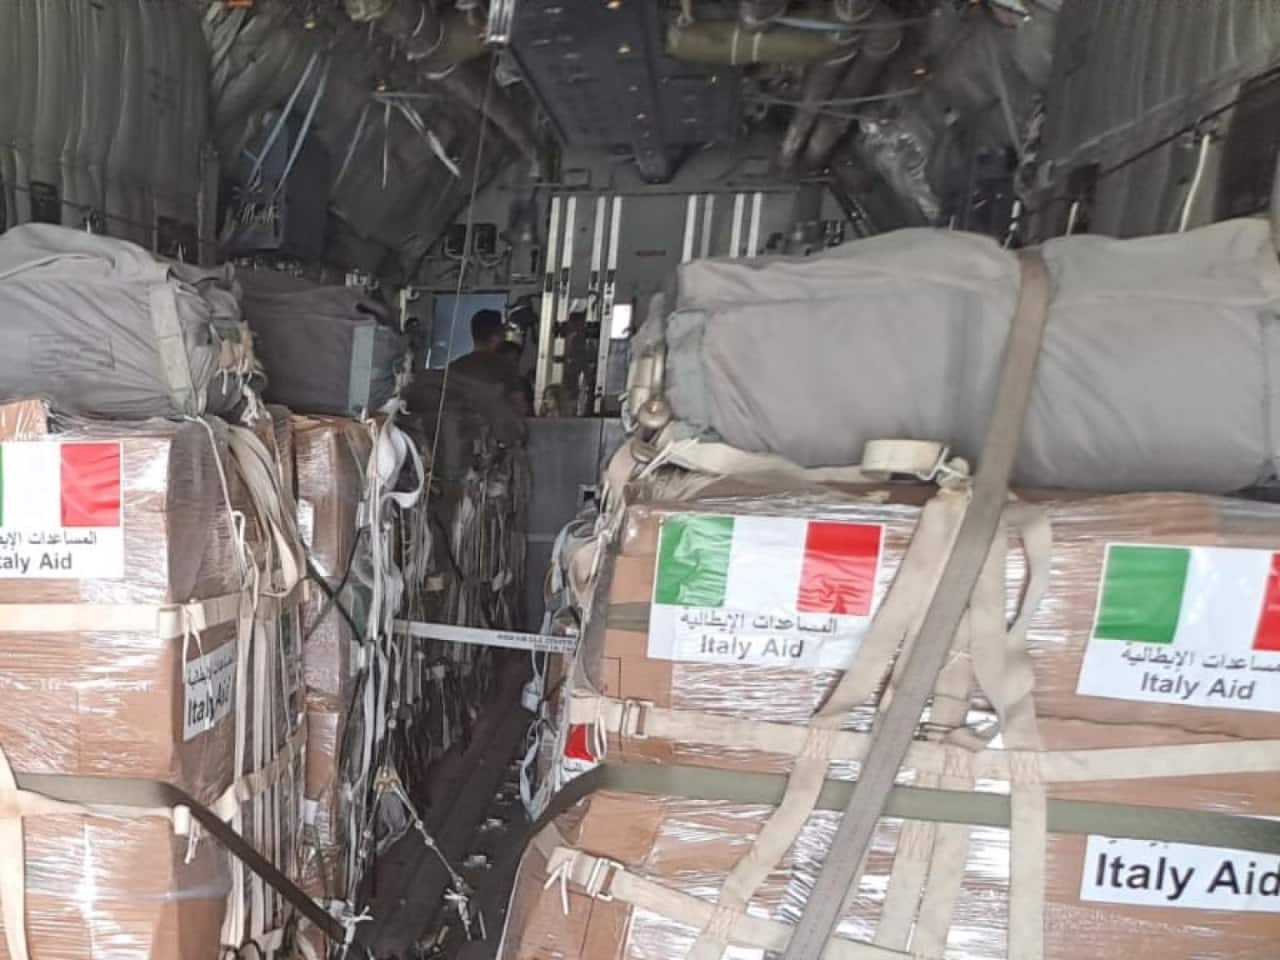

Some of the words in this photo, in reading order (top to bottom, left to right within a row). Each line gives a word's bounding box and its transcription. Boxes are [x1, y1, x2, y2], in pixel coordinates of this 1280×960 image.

[39, 551, 73, 570] Aid
[699, 633, 752, 660] Italy
[760, 637, 805, 659] Aid
[1140, 670, 1200, 700] Italy
[1206, 678, 1256, 701] Aid
[1095, 852, 1196, 901] Italy
[1206, 859, 1280, 898] Aid
